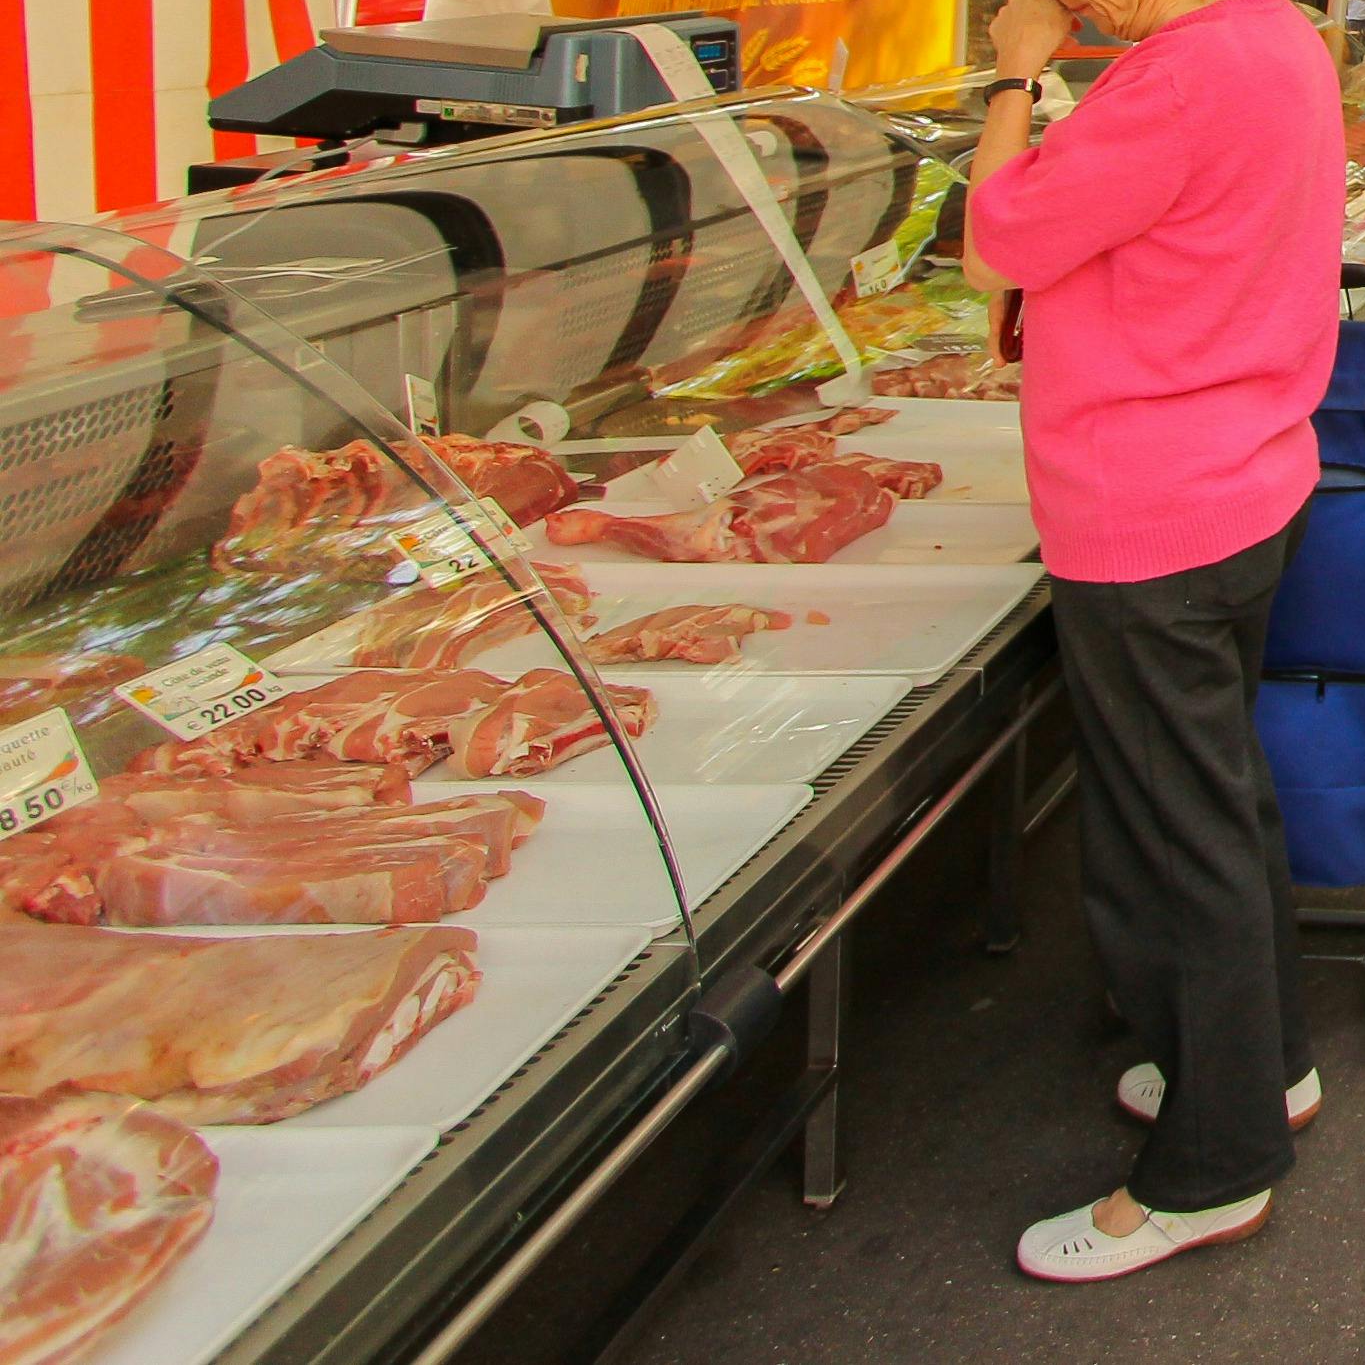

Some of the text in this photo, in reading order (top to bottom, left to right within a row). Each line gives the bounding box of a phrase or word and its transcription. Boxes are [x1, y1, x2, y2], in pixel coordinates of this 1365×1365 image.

[200, 688, 266, 725] 22.00
[0, 726, 49, 754] quette
[0, 748, 36, 774] auté
